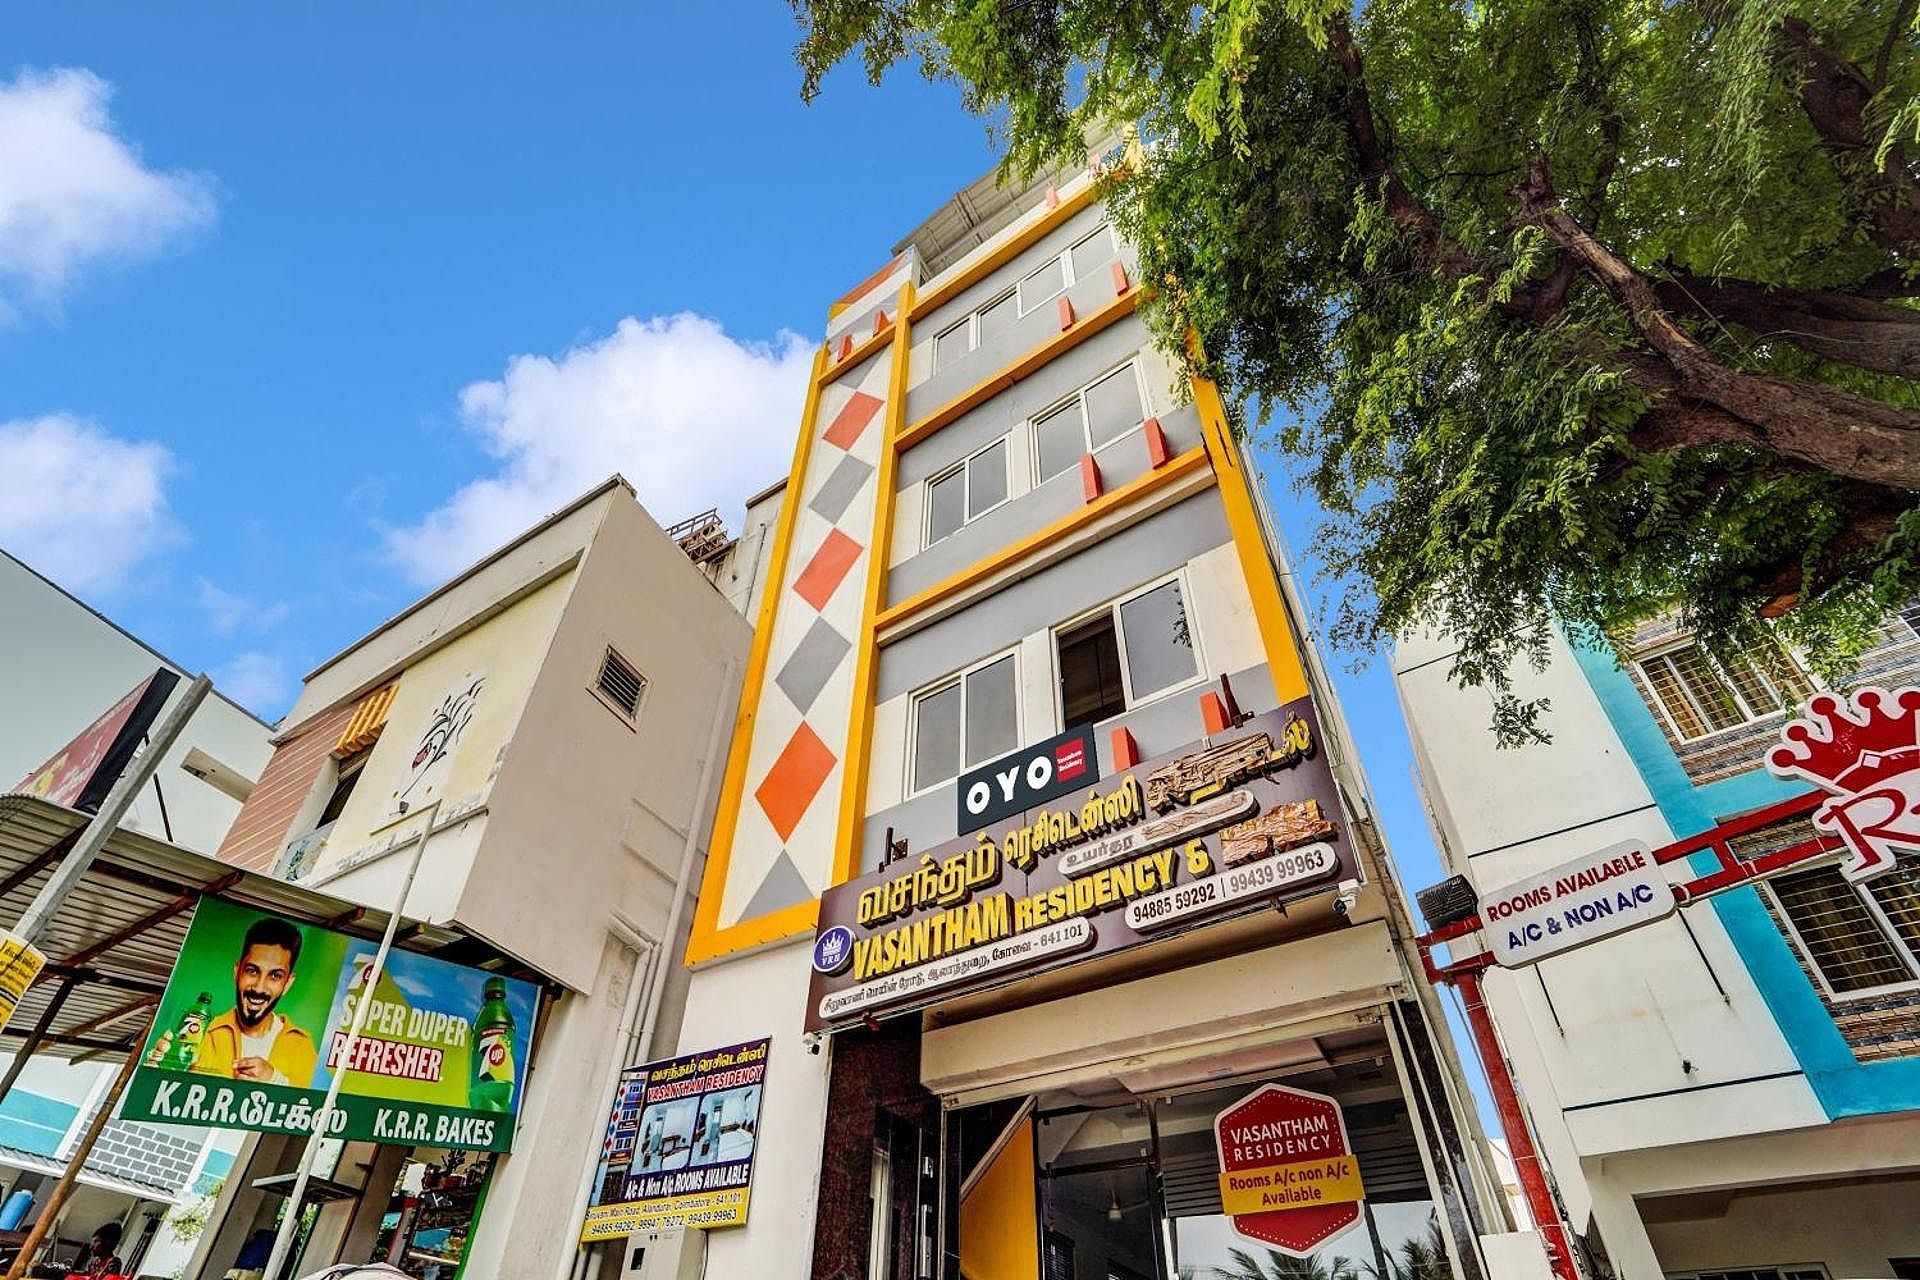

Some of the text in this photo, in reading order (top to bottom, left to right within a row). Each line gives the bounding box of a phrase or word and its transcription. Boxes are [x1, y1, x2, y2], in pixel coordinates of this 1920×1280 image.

[966, 755, 1053, 815] OYO
[857, 831, 998, 924] வசந்தம்
[1133, 898, 1172, 923] 94885
[1175, 882, 1216, 910] 59292
[1229, 864, 1275, 893] 99439
[1277, 849, 1325, 880] 99963
[1486, 850, 1648, 922] ROOMS AVAILABLE
[853, 892, 1009, 981] VASANTHAM
[1014, 847, 1175, 932] RESIDENCY
[1064, 924, 1083, 940] 101
[1508, 884, 1654, 949] A/C & NON A/C
[407, 1008, 469, 1047] DUPER
[647, 1065, 765, 1103] VASANTHAM RESIDENCY
[373, 1108, 495, 1146] K.R.R. BAKES
[1230, 1114, 1329, 1145] VASANTHAM
[1233, 1133, 1330, 1162] RESIDENCY
[674, 1169, 704, 1193] ROOMS
[703, 1164, 750, 1189] AVAILABLE
[1229, 1161, 1350, 1191] Rooms A/c non A/c
[1262, 1186, 1322, 1206] Available
